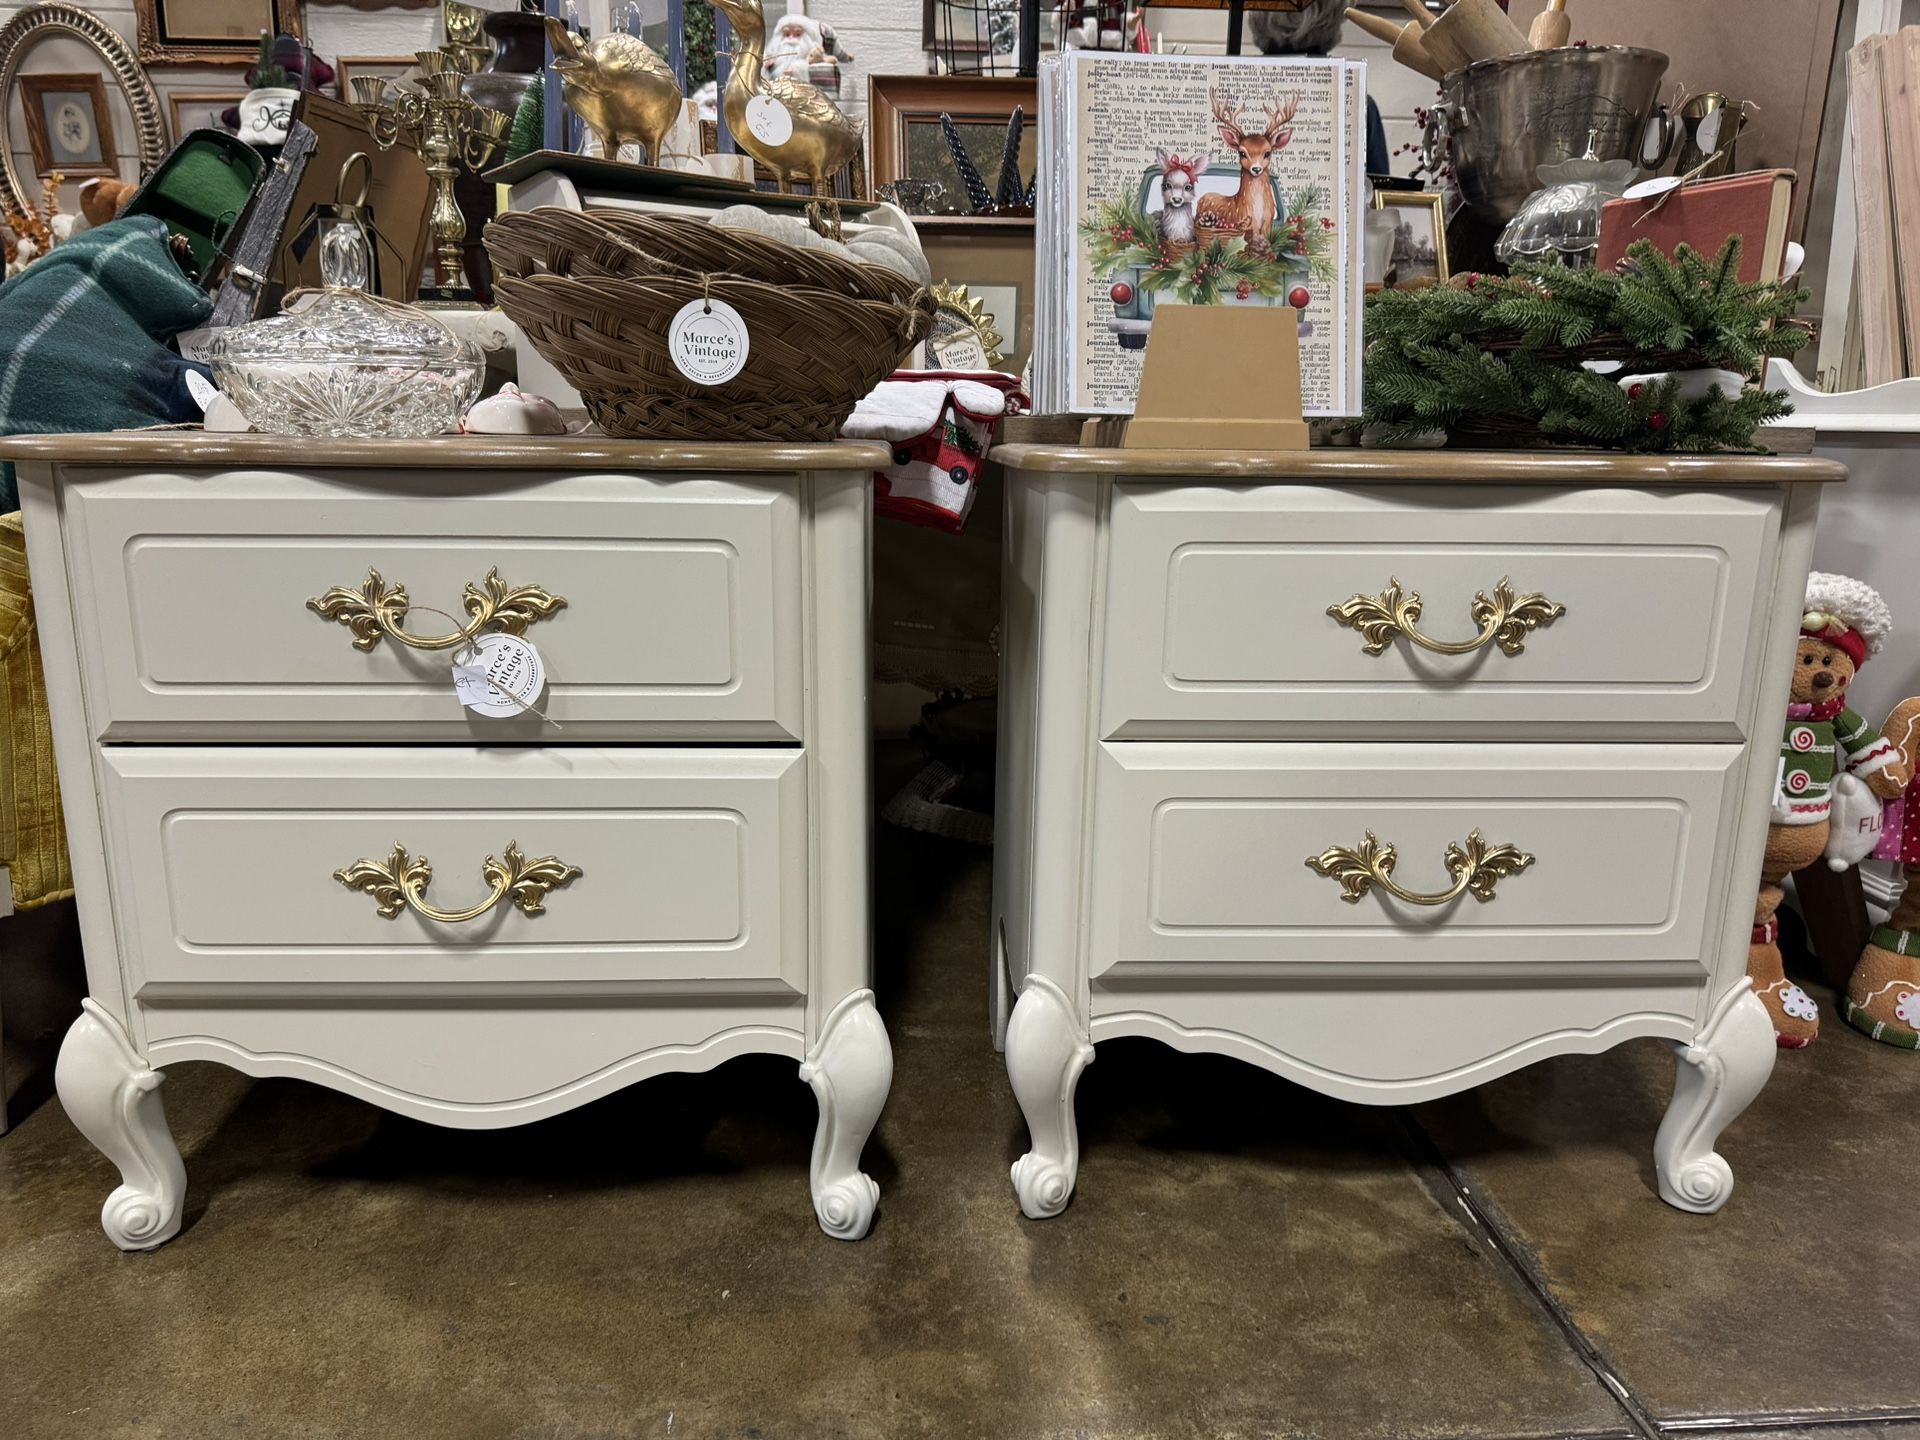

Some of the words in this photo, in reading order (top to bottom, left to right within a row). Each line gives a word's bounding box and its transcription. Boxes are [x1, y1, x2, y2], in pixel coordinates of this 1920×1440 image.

[683, 331, 734, 345] Marce's
[684, 344, 736, 360] Vintage
[944, 347, 974, 358] Marce's
[948, 354, 976, 364] Vintage
[680, 356, 688, 368] HOME
[486, 644, 512, 683] arce's
[488, 648, 524, 697] Vntage
